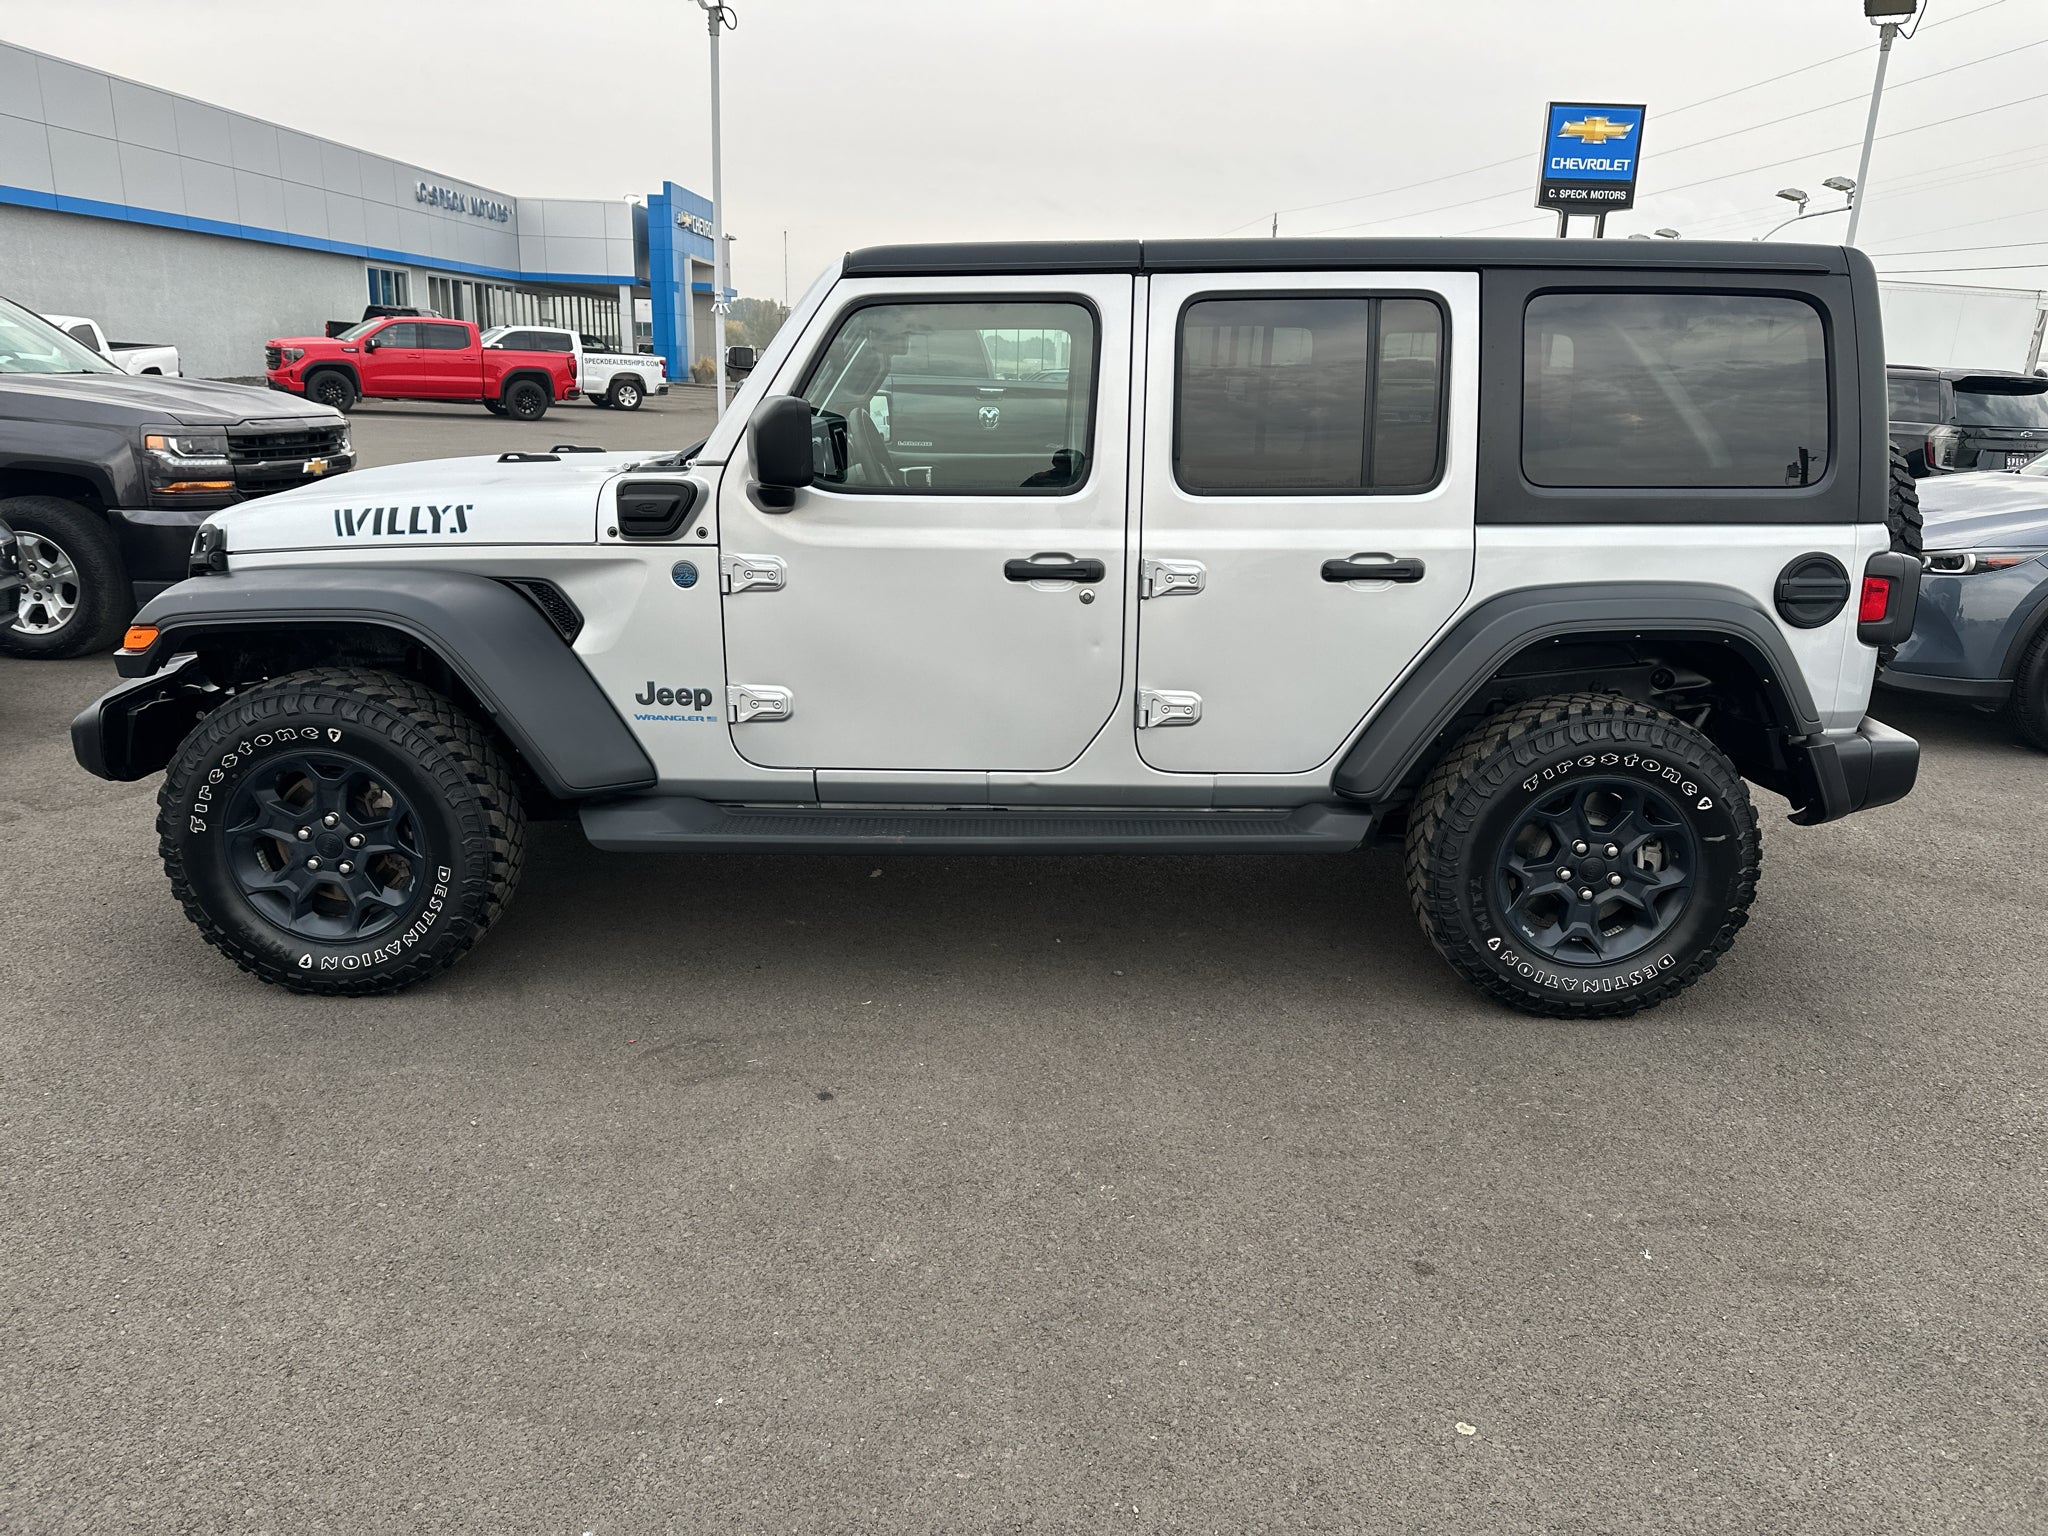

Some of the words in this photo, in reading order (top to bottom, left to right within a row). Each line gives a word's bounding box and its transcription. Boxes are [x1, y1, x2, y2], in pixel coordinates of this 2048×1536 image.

[1551, 157, 1631, 171] CHEVROLET
[428, 185, 465, 213] SPECK
[467, 195, 509, 223] MOTORS
[1548, 188, 1557, 199] C.
[1559, 188, 1588, 200] SPECK
[1590, 190, 1627, 201] MOTORS
[584, 357, 660, 367] SPECKDEALERSHIPS.COM
[334, 504, 474, 537] WILLYS
[635, 681, 713, 711] Jeep
[634, 714, 705, 722] WRANGLER
[1523, 753, 1699, 797] Firestone
[320, 866, 451, 971] DESTINATION
[1500, 950, 1676, 993] DESTINATION
